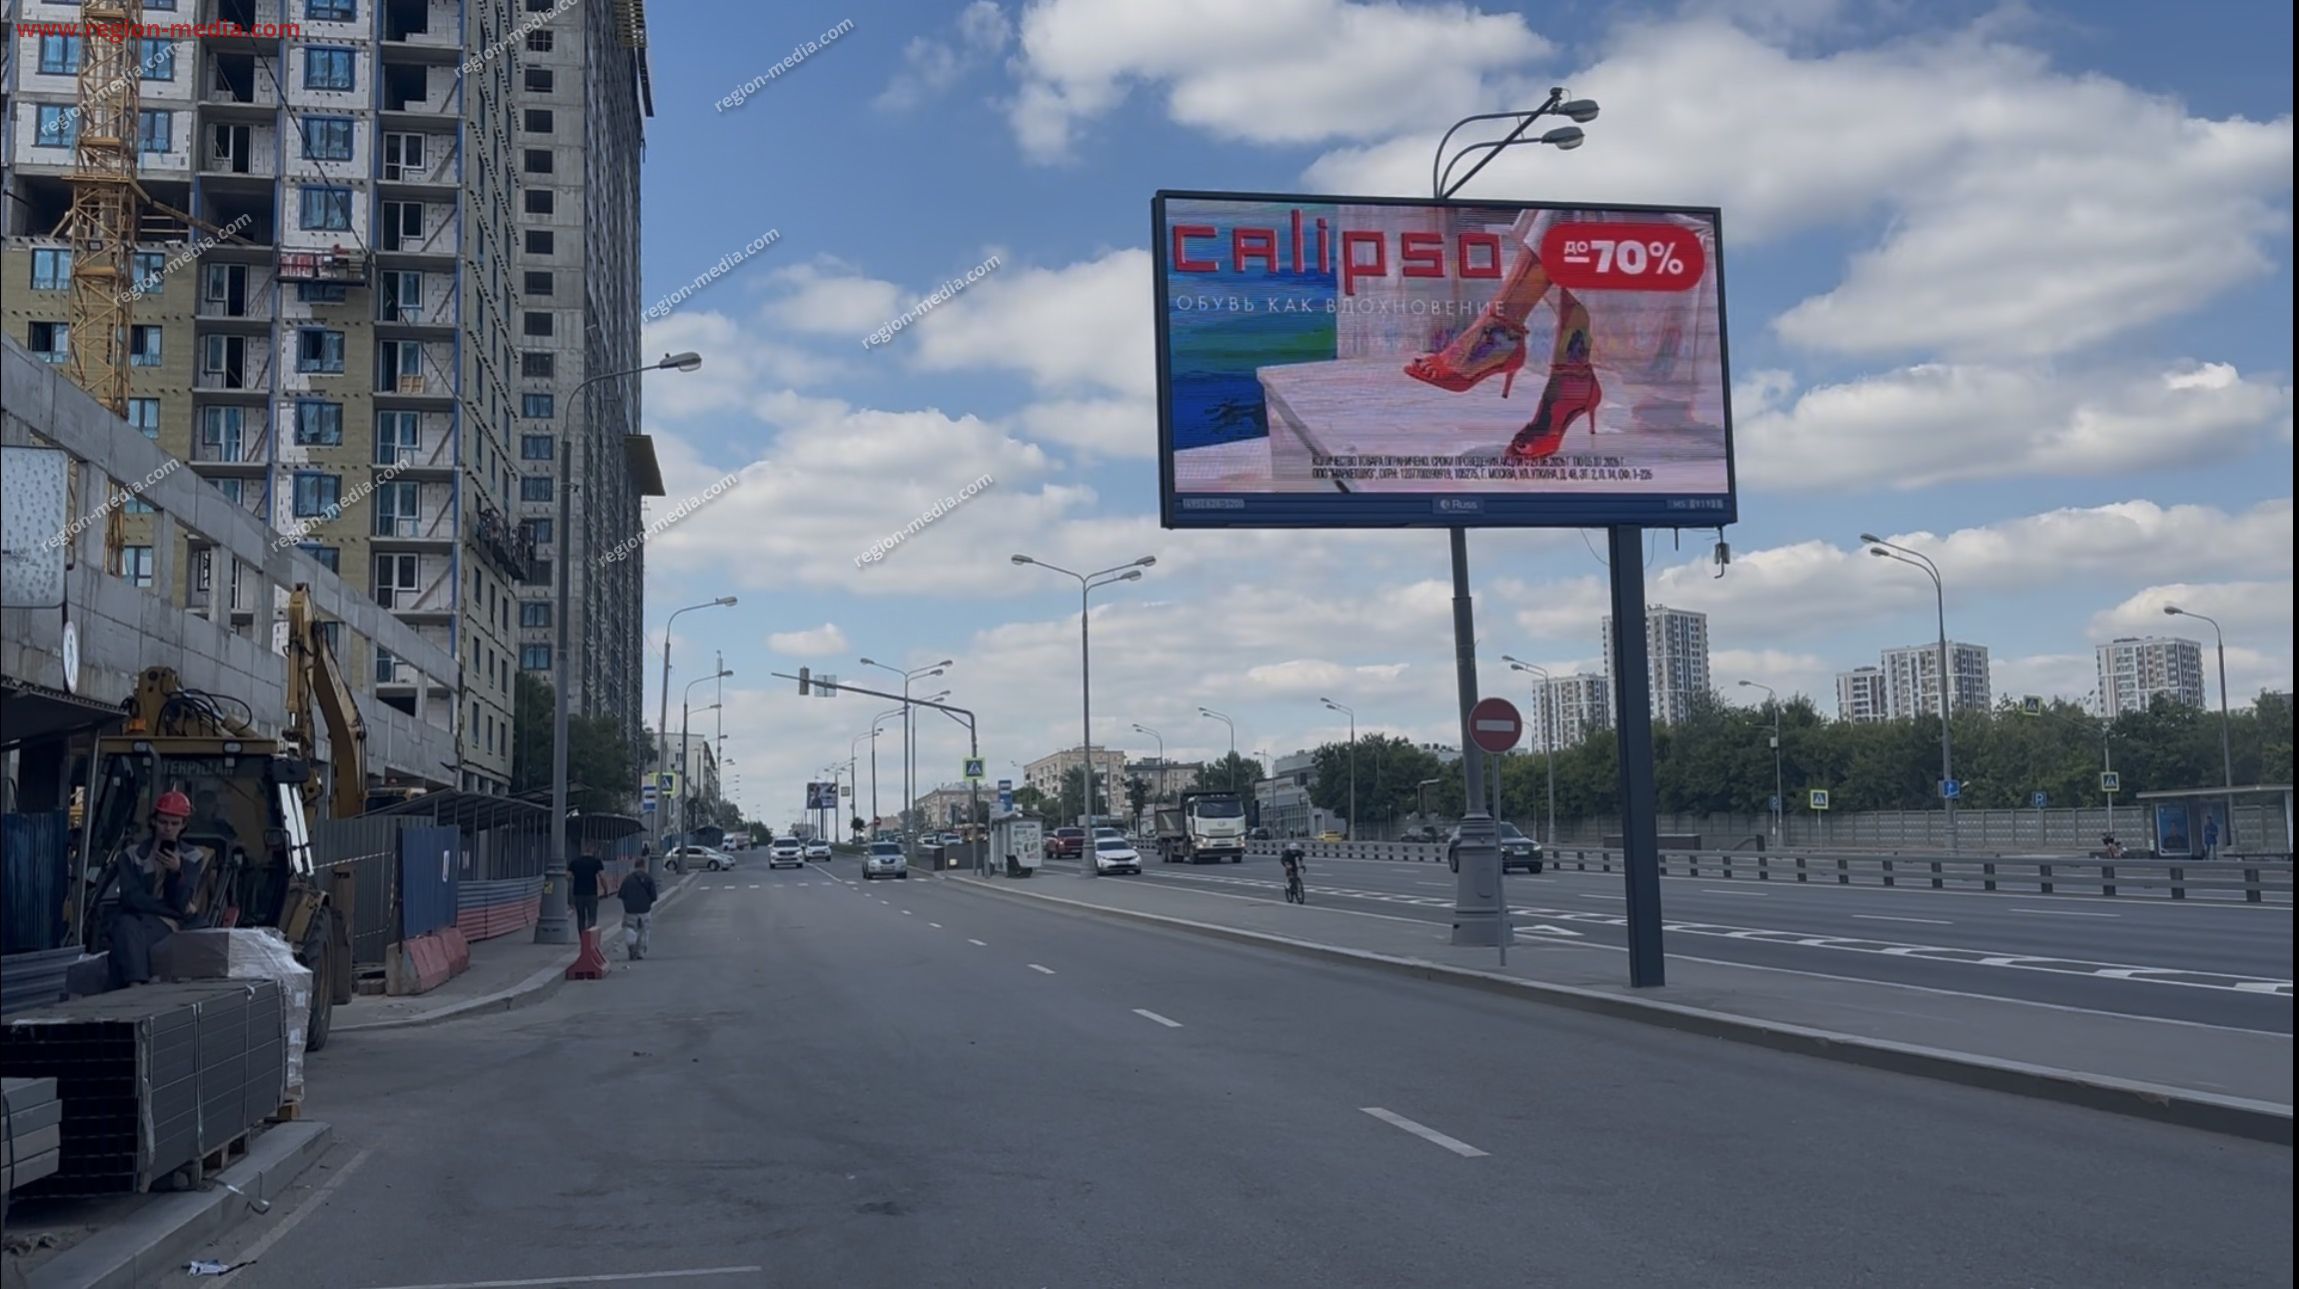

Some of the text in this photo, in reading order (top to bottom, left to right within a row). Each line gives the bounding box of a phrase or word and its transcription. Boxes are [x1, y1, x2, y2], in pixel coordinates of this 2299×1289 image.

[1563, 242, 1589, 255] ДО
[1176, 296, 1506, 317] ОБУВЬ КАК ВДОХНОВЕНИЕ
[1312, 468, 1328, 480] ООО
[1452, 499, 1477, 509] Russ
